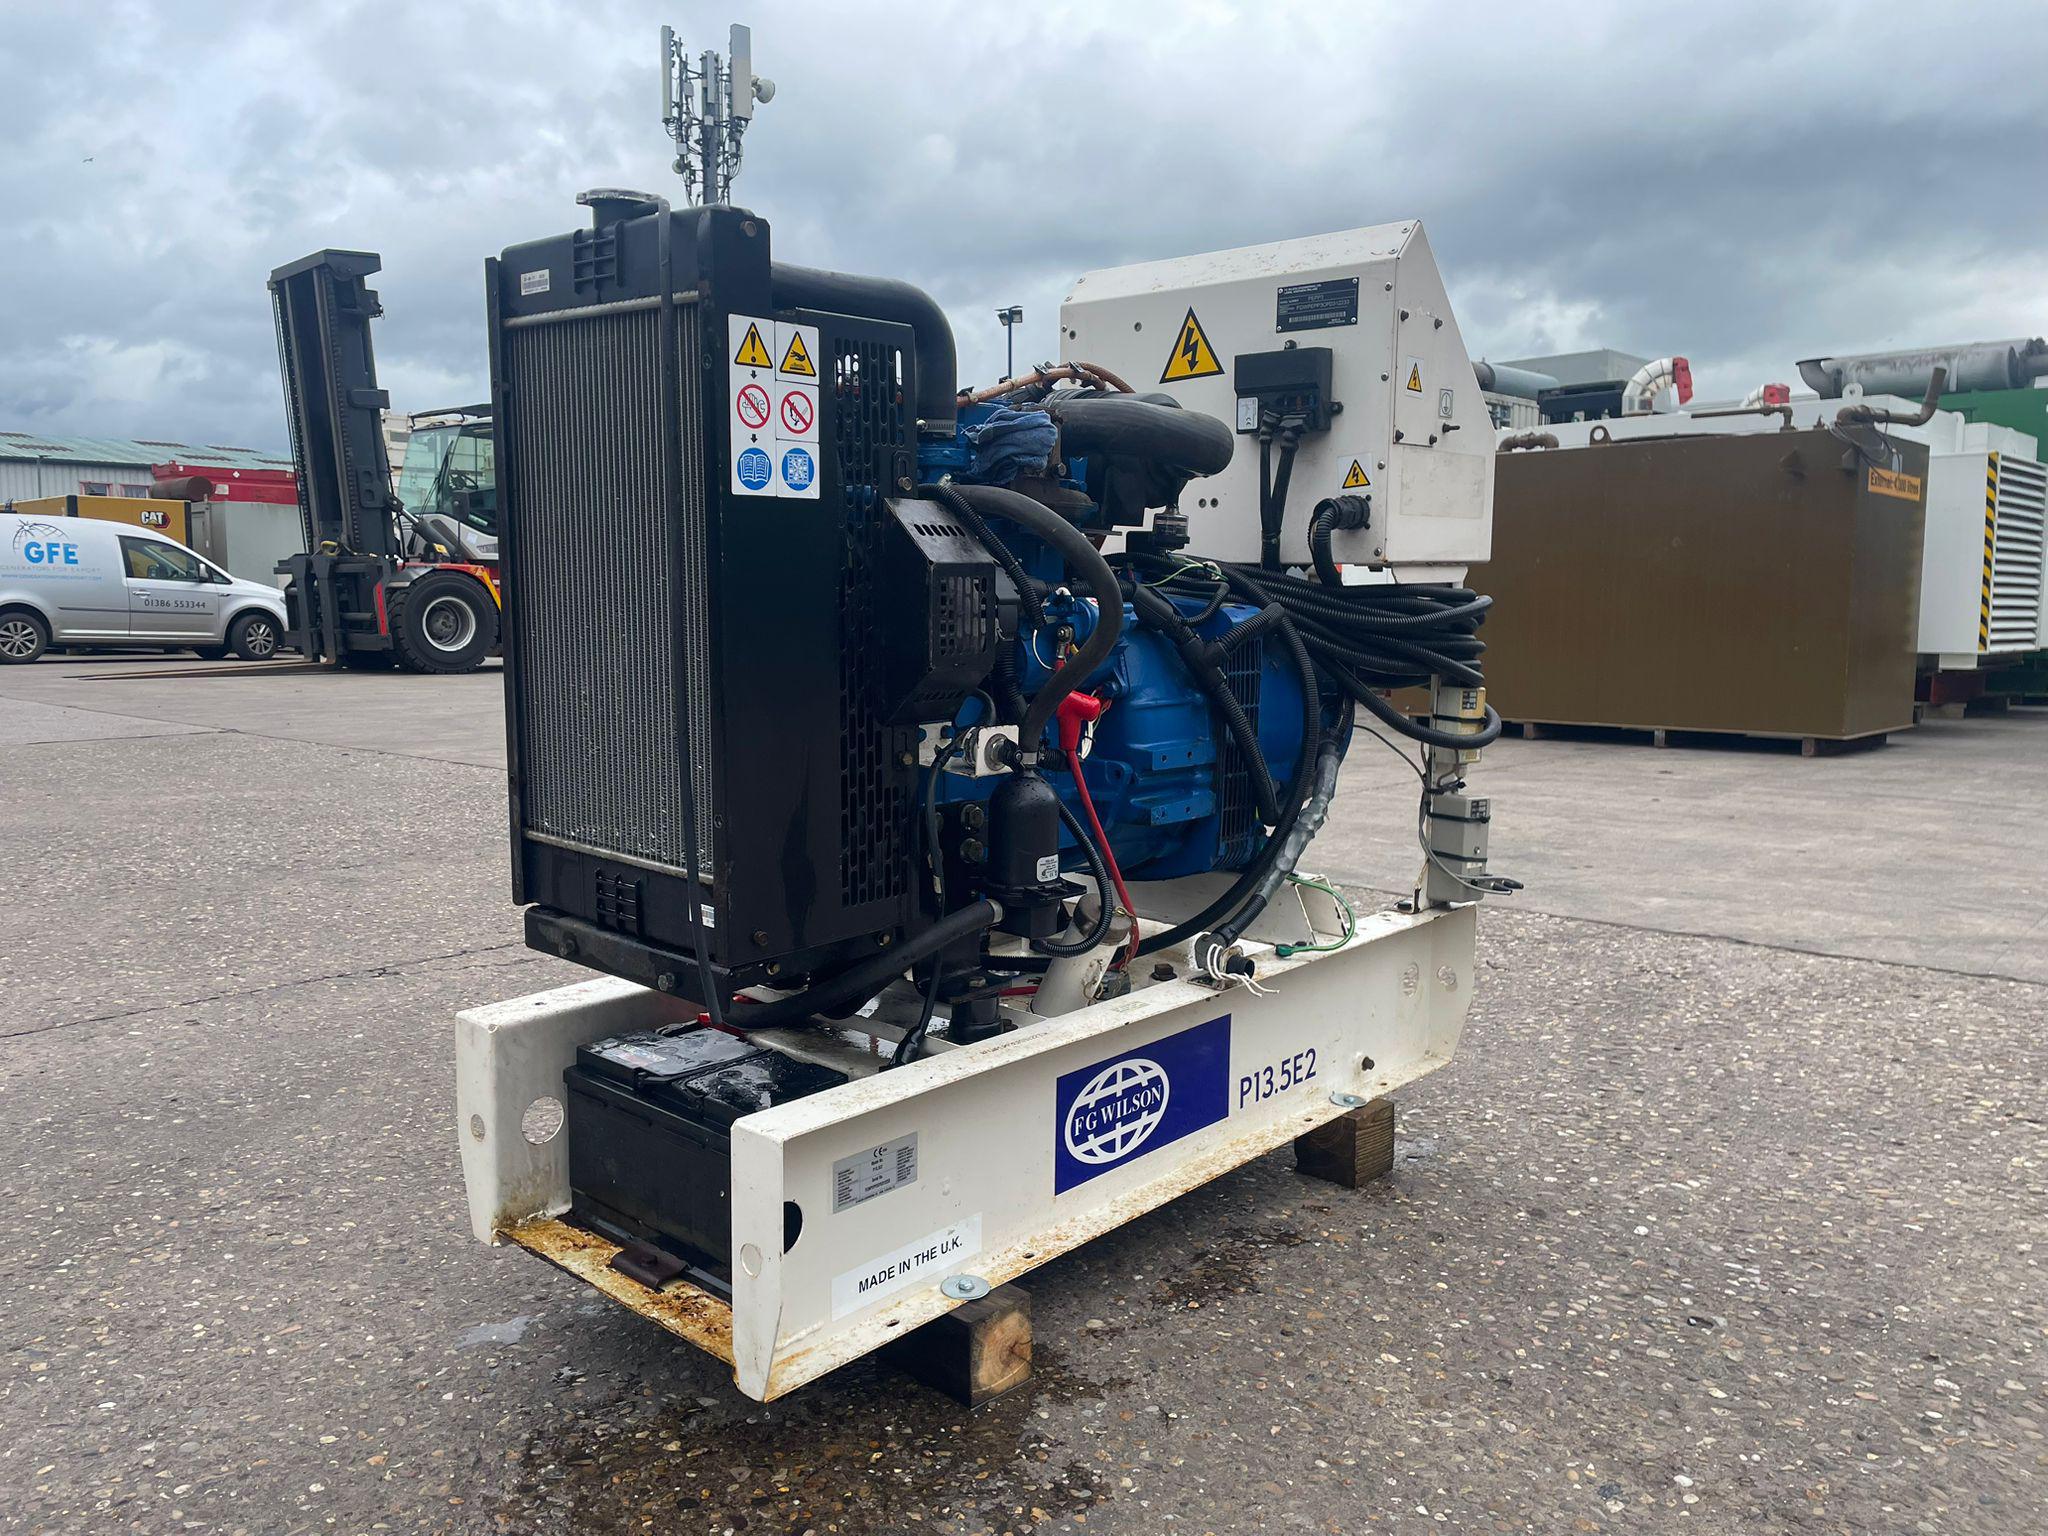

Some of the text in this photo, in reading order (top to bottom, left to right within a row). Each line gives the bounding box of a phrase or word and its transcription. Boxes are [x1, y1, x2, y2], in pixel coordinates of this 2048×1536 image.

[141, 511, 164, 524] CAT
[24, 541, 79, 564] GFE
[144, 599, 206, 609] 01386 553344
[1240, 1048, 1317, 1109] P13.5E2
[1074, 1084, 1162, 1137] FG WILSON
[858, 1236, 963, 1293] MADE IN THE U.K.
